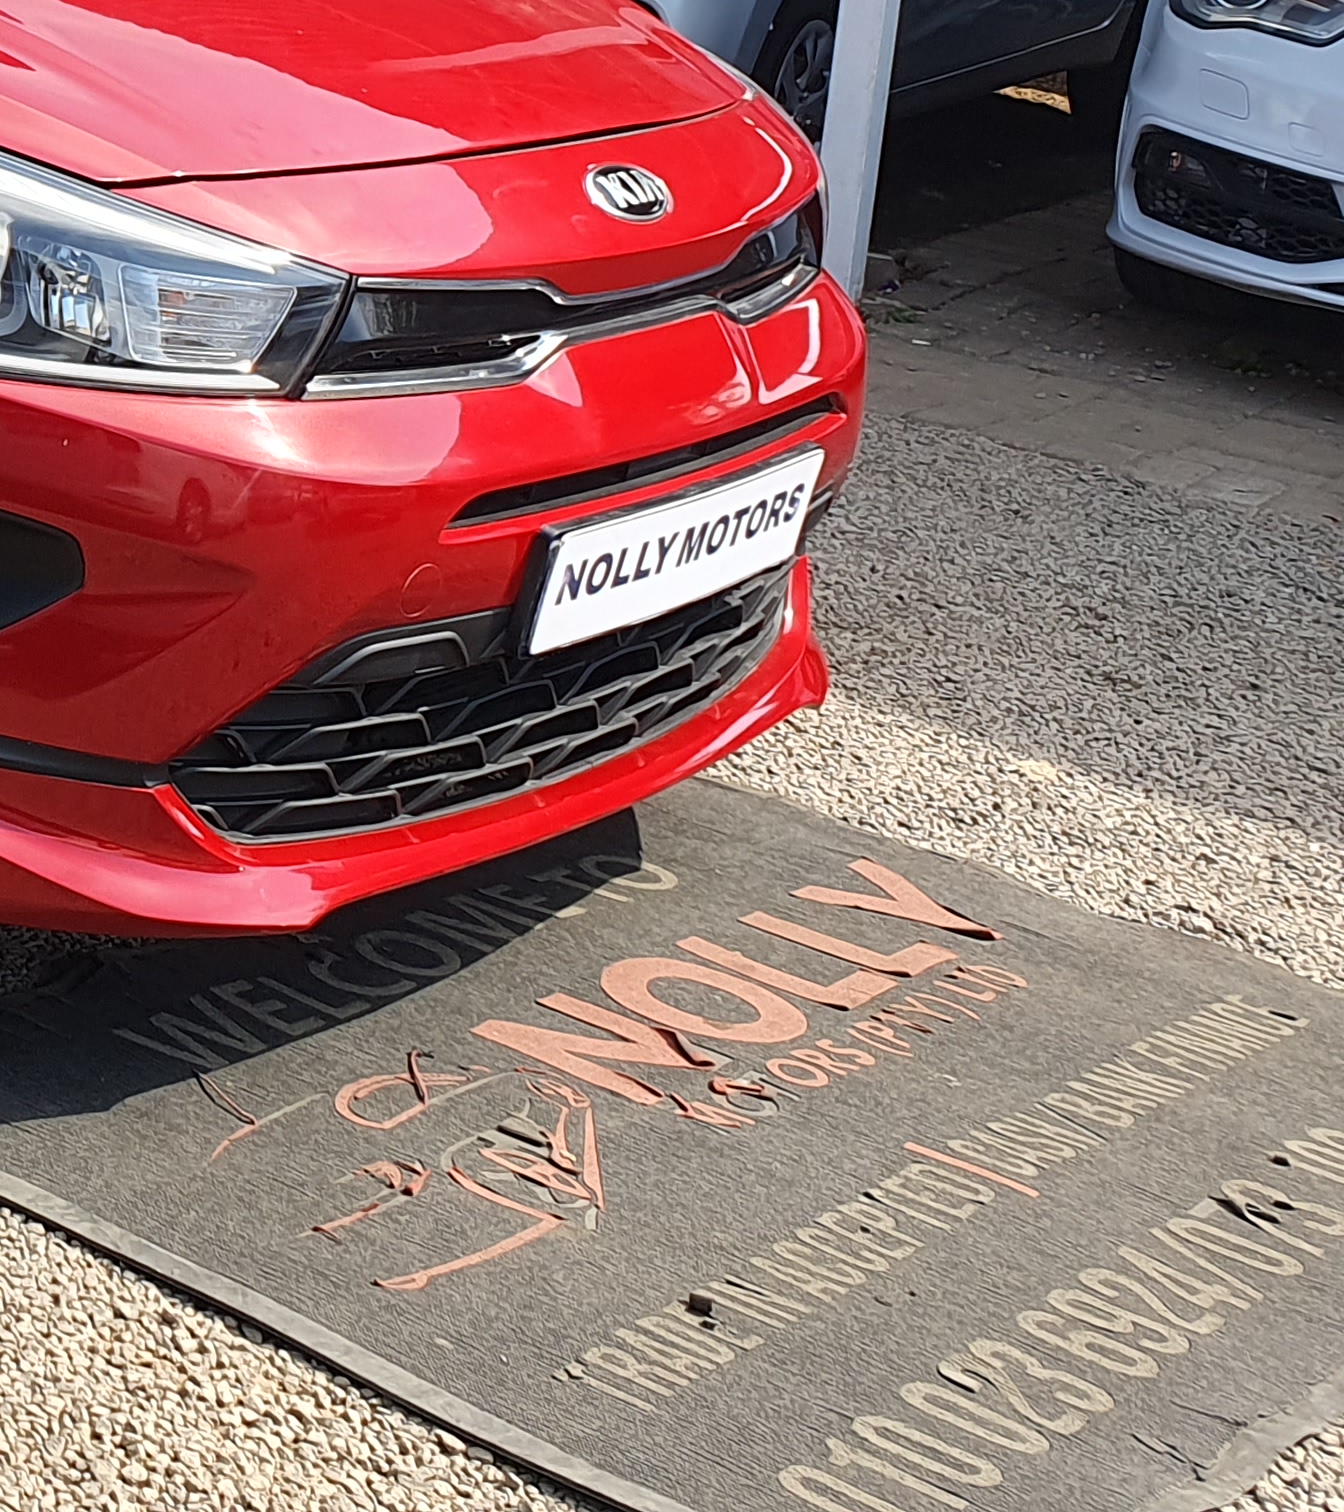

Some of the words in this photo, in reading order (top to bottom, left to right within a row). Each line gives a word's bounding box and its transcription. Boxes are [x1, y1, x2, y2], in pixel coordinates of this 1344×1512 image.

[596, 171, 665, 208] KIA
[554, 531, 681, 606] NOLLY
[675, 482, 806, 568] MOTORS
[111, 884, 589, 1074] WELCOME
[524, 854, 679, 903] TO
[470, 855, 1004, 1107] NOLLY
[847, 991, 981, 1059] (PTY)
[933, 964, 1029, 1003] LTD
[1129, 994, 1311, 1082] FINANCE
[946, 1053, 1196, 1178] CASH/BANK
[749, 1162, 996, 1302] ACCEPTED
[553, 1294, 767, 1411] TRADE
[690, 1274, 814, 1329] IN
[777, 1415, 1003, 1512] 010
[898, 1337, 1115, 1456] 023
